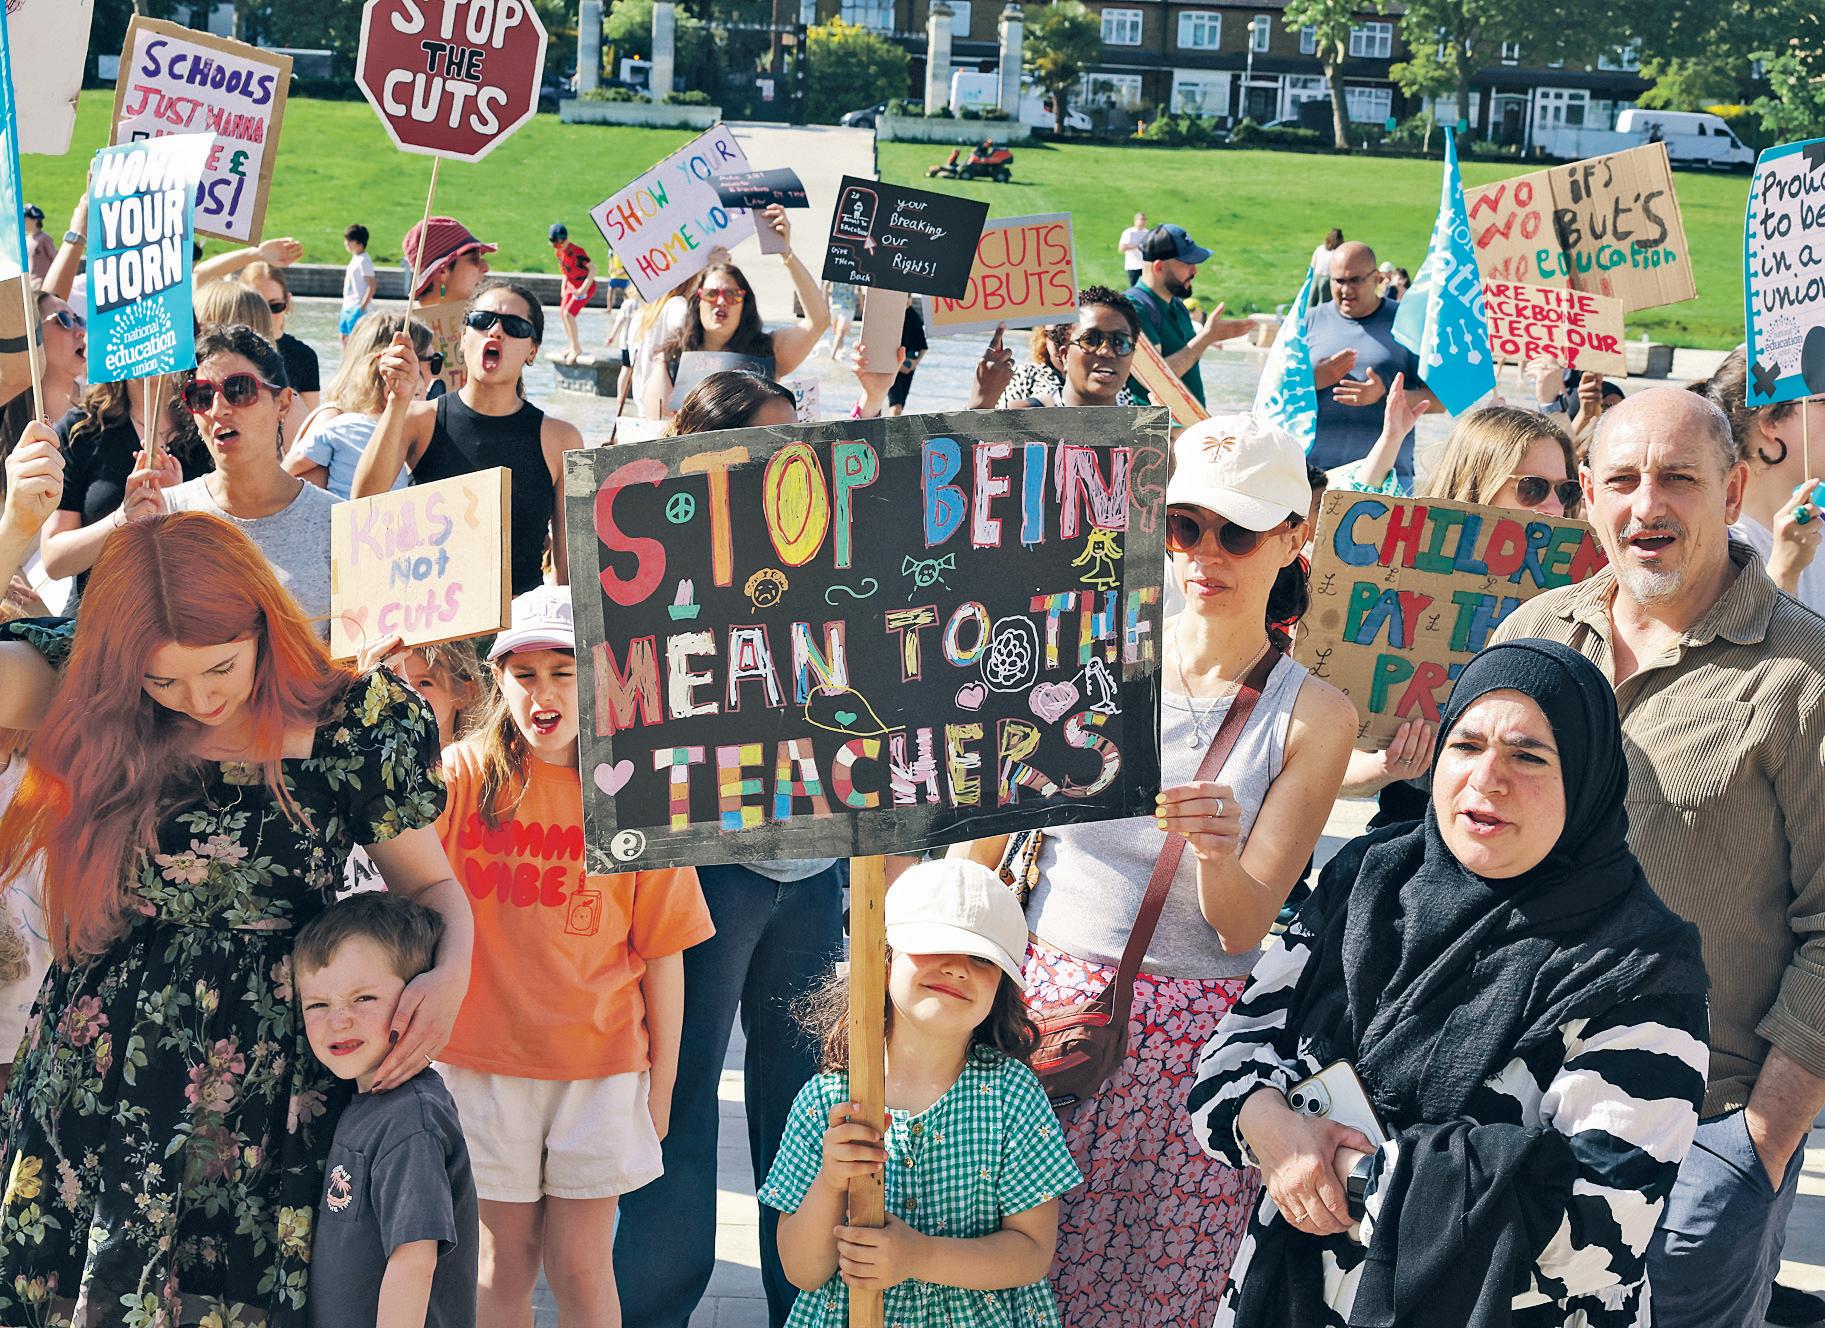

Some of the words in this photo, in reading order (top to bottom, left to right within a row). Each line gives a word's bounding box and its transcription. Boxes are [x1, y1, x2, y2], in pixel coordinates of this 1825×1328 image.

[390, 0, 524, 48] STOP
[141, 40, 274, 105] SCHOOLS
[421, 40, 486, 82] THE
[126, 84, 204, 128] JUST
[383, 69, 508, 135] CUTS
[205, 104, 264, 144] WANNA
[606, 180, 669, 240] SHOW
[676, 140, 736, 184] YOUR
[896, 200, 928, 212] your
[1469, 181, 1533, 220] NO
[100, 189, 185, 250] YOUR
[881, 234, 908, 246] Our
[890, 212, 947, 240] Breaking
[1477, 210, 1542, 250] NO
[1760, 207, 1791, 240] to
[892, 252, 937, 276] Rights!
[978, 224, 1072, 269] CUTS.
[1761, 244, 1792, 277] in
[1799, 244, 1822, 267] a
[94, 236, 182, 306] HORN
[850, 270, 871, 282] Back
[1483, 283, 1531, 302] ARE
[1536, 288, 1600, 314] THE
[105, 330, 176, 370] education
[124, 318, 160, 344] national
[1566, 328, 1622, 355] OUR
[1765, 334, 1803, 352] education
[132, 358, 158, 376] union
[594, 438, 880, 606] STOP
[920, 437, 1166, 551] BEING
[1333, 500, 1609, 589] CHILDREN
[1342, 581, 1434, 650] PAY
[1449, 590, 1527, 653] TH
[592, 620, 850, 738] MEAN
[884, 601, 993, 683] TO
[1029, 586, 1161, 669] THE
[1368, 653, 1465, 722] PR
[651, 712, 1122, 833] TEACHERS
[465, 857, 568, 908] VIBE
